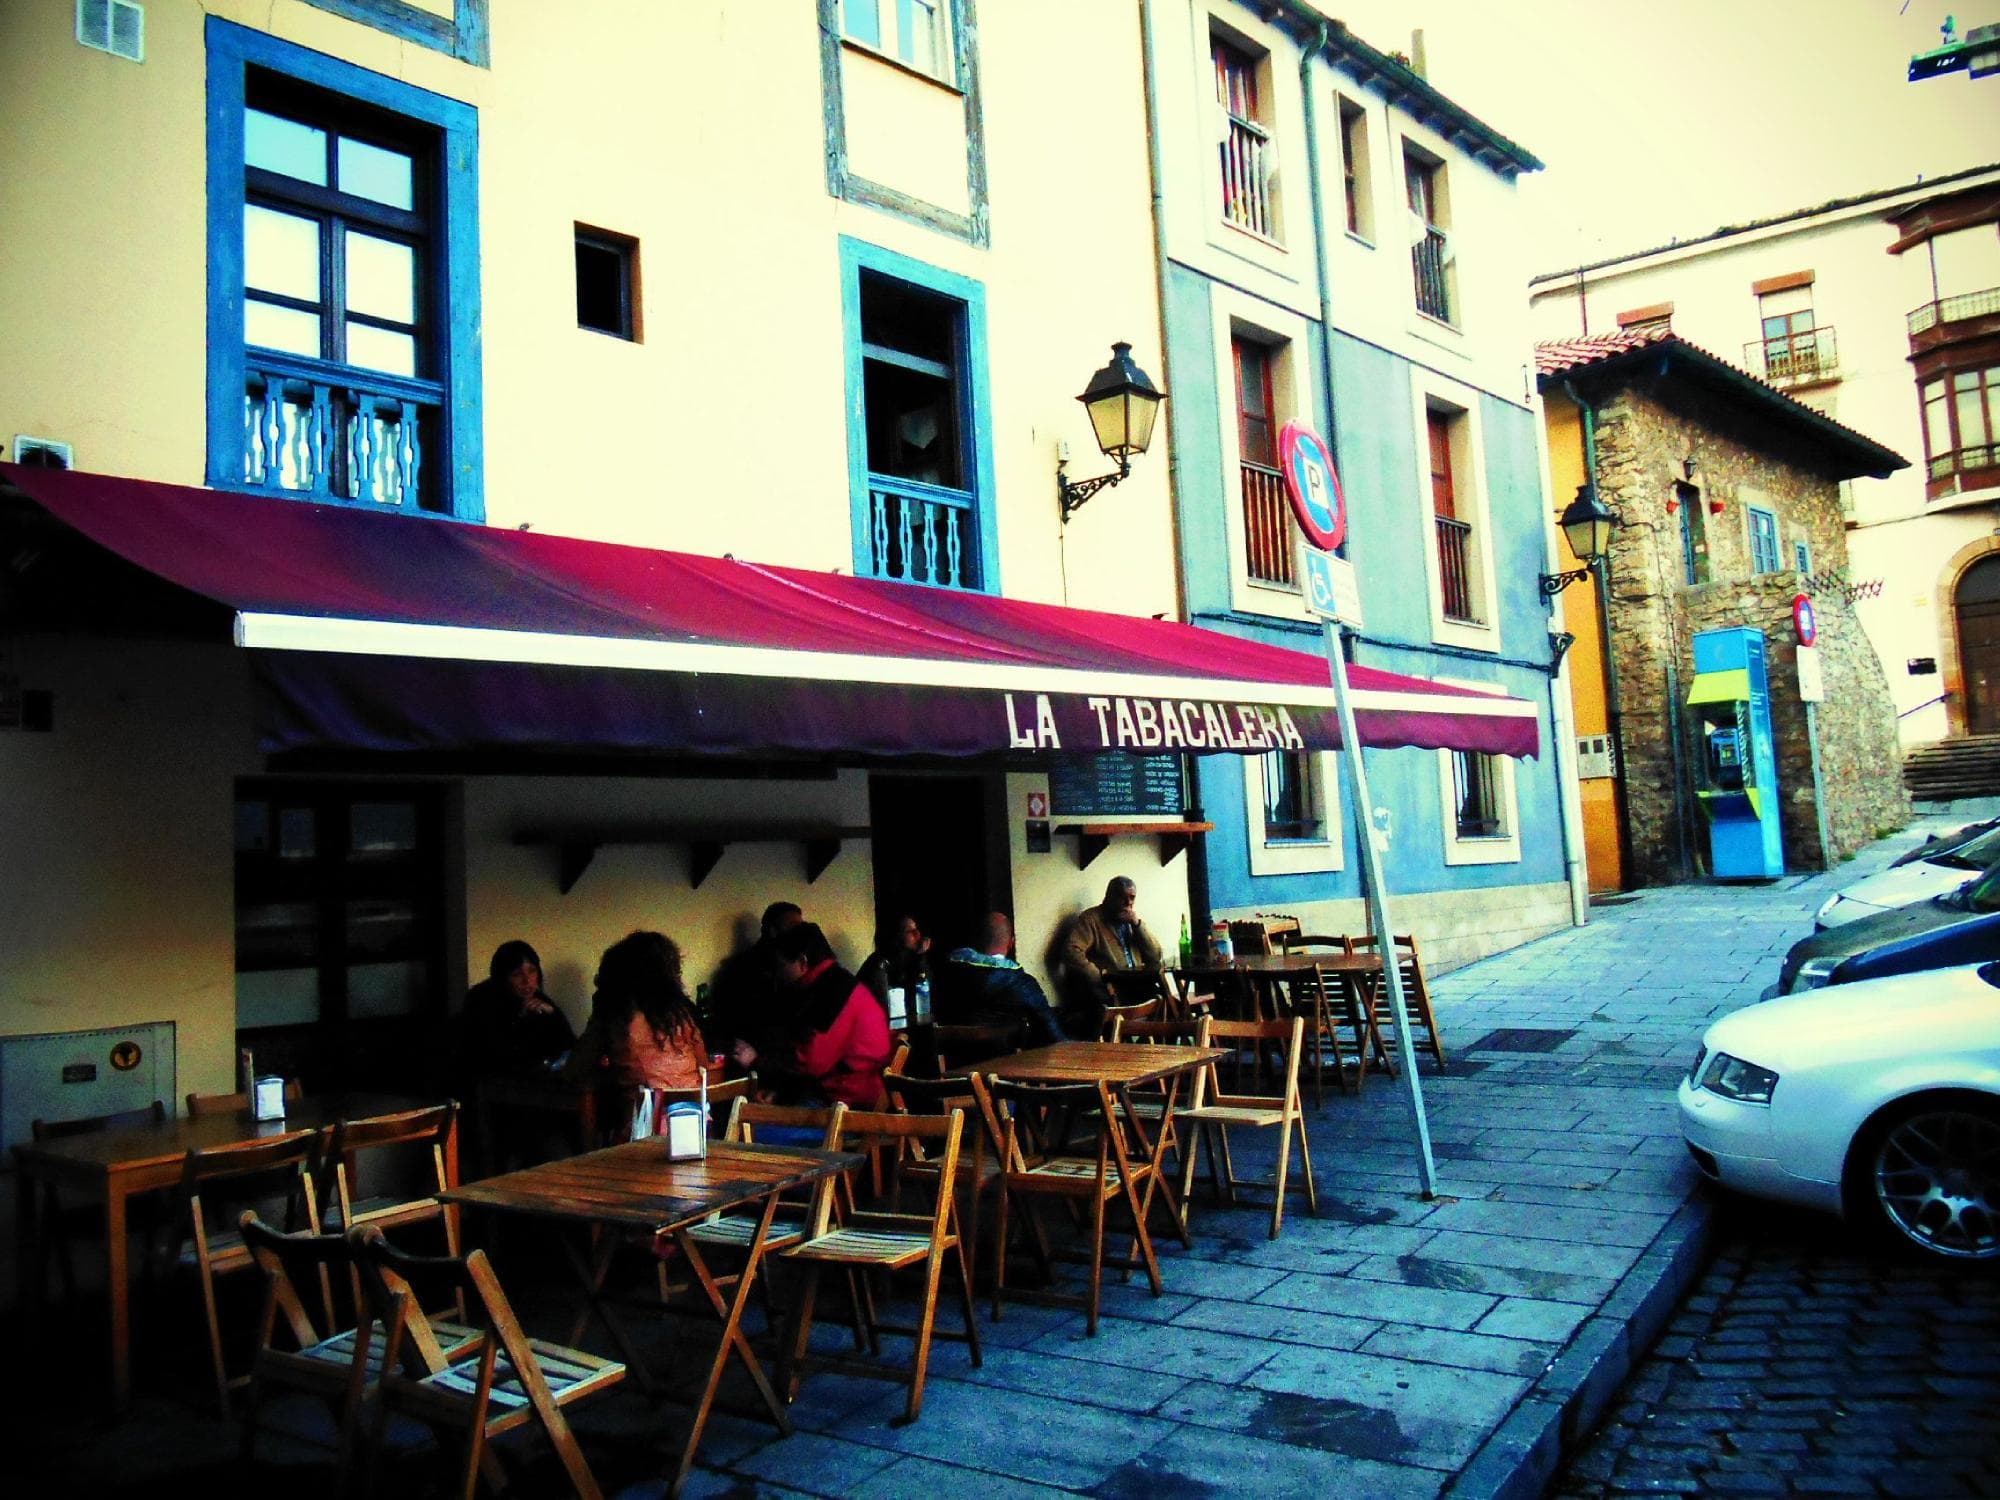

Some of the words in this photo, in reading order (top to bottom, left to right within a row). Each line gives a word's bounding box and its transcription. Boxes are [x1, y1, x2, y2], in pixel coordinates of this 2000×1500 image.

[1308, 464, 1321, 499] P
[1004, 693, 1061, 749] LA
[1088, 697, 1305, 750] TABACALERA
